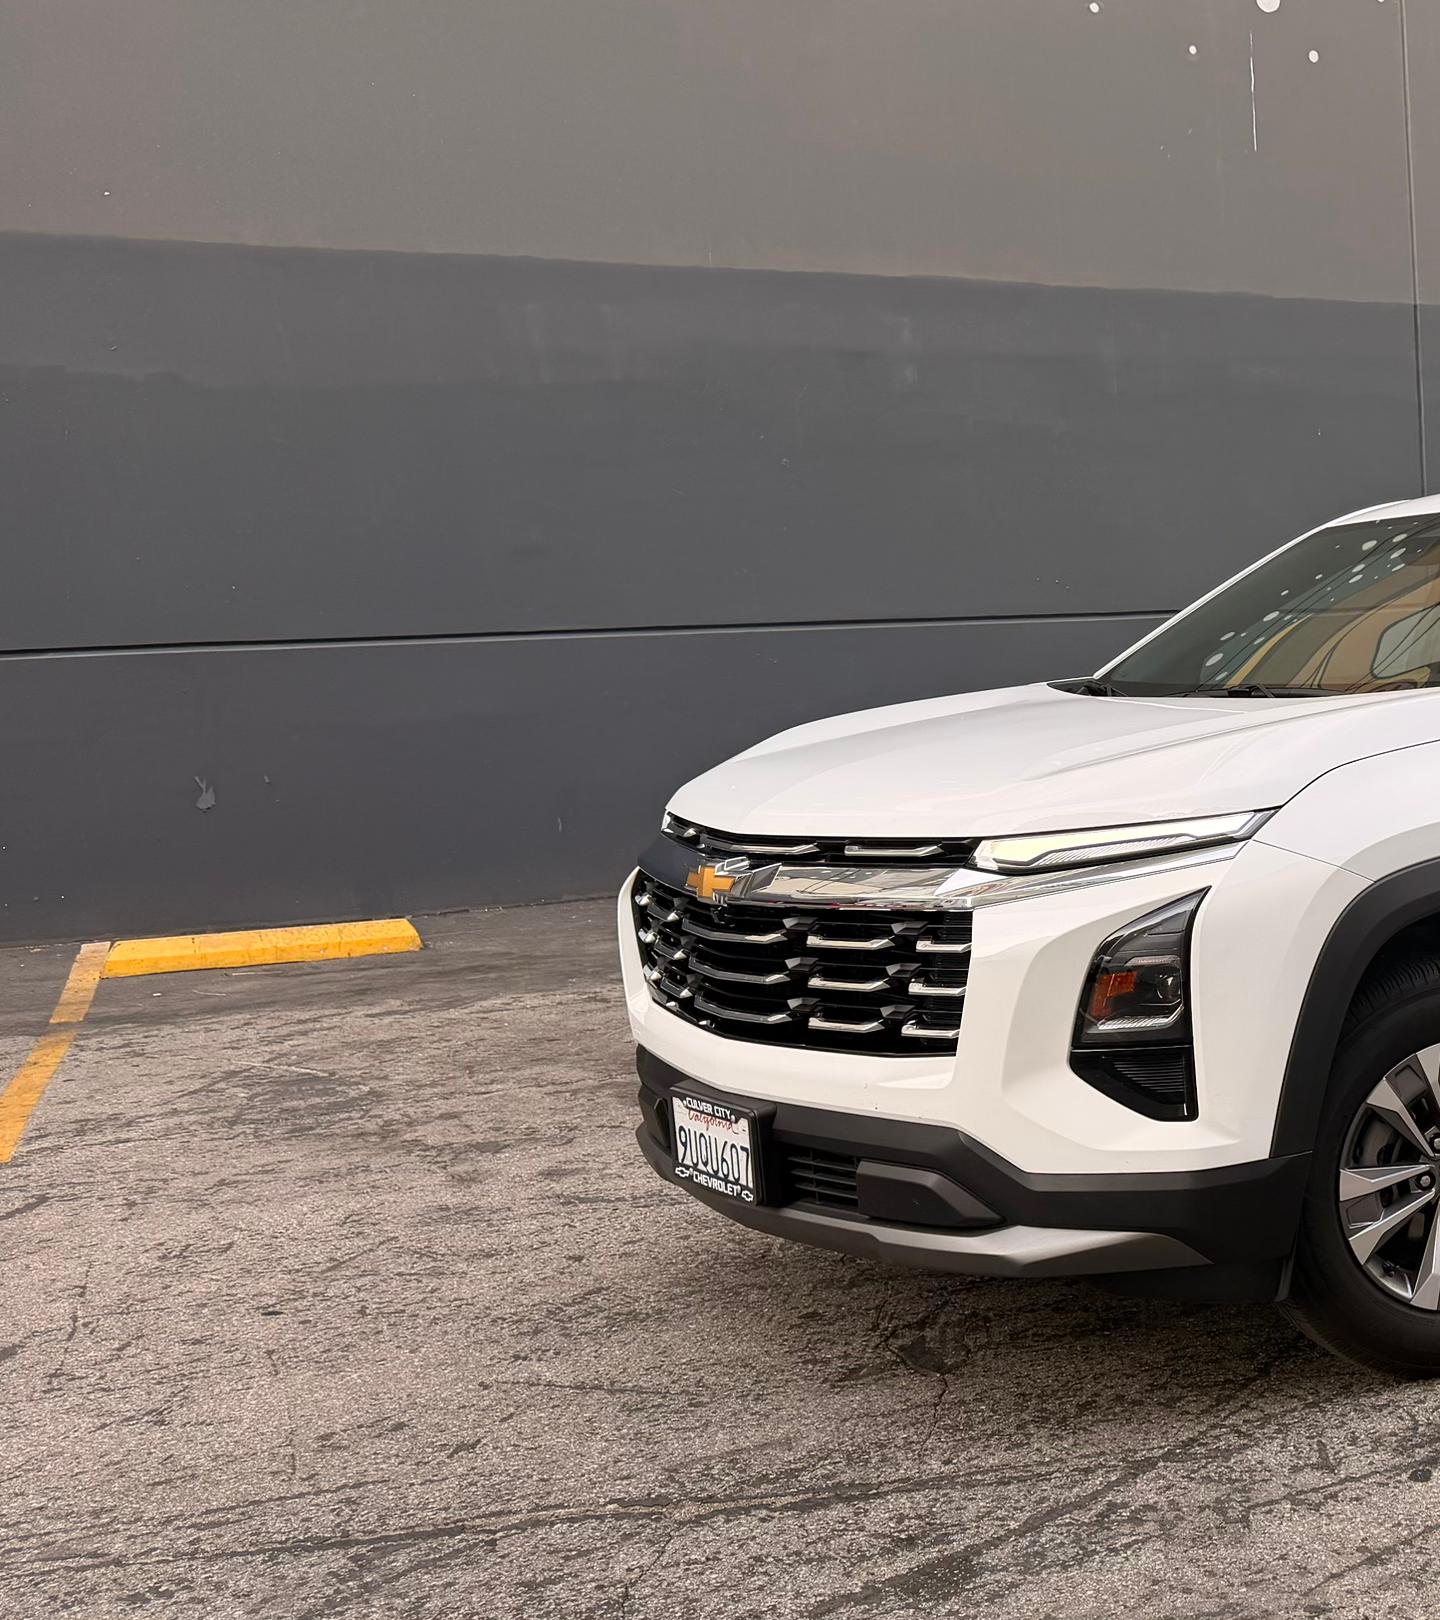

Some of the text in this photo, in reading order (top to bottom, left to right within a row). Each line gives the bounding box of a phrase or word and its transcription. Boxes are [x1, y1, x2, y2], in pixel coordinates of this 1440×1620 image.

[686, 1097, 731, 1120] CULVER CITY
[679, 1125, 751, 1188] 9UQU607
[693, 1171, 737, 1196] CHEVROLET
